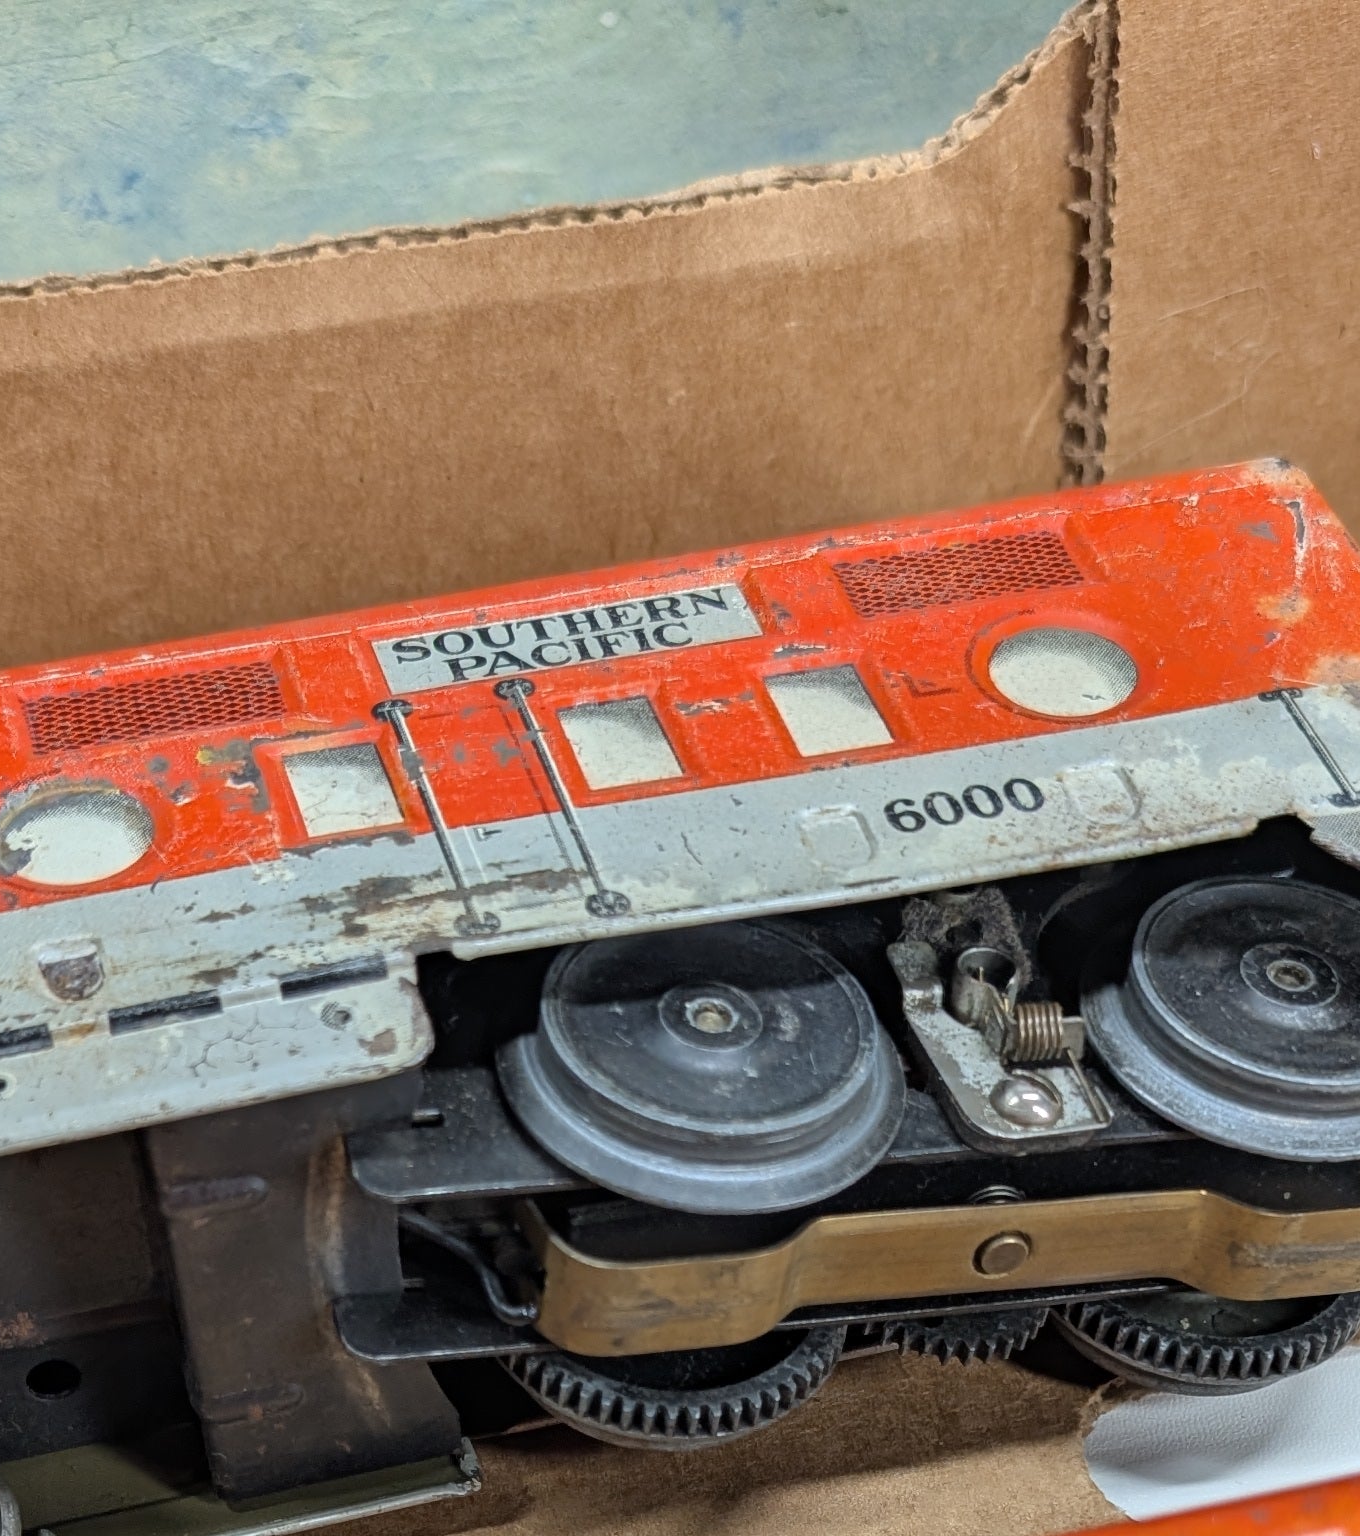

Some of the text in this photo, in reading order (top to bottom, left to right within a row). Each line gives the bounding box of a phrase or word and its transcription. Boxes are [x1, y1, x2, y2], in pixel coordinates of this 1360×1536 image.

[392, 588, 729, 664] SOUTHERN
[442, 622, 693, 683] PACIFIC
[884, 778, 1045, 833] 6000
